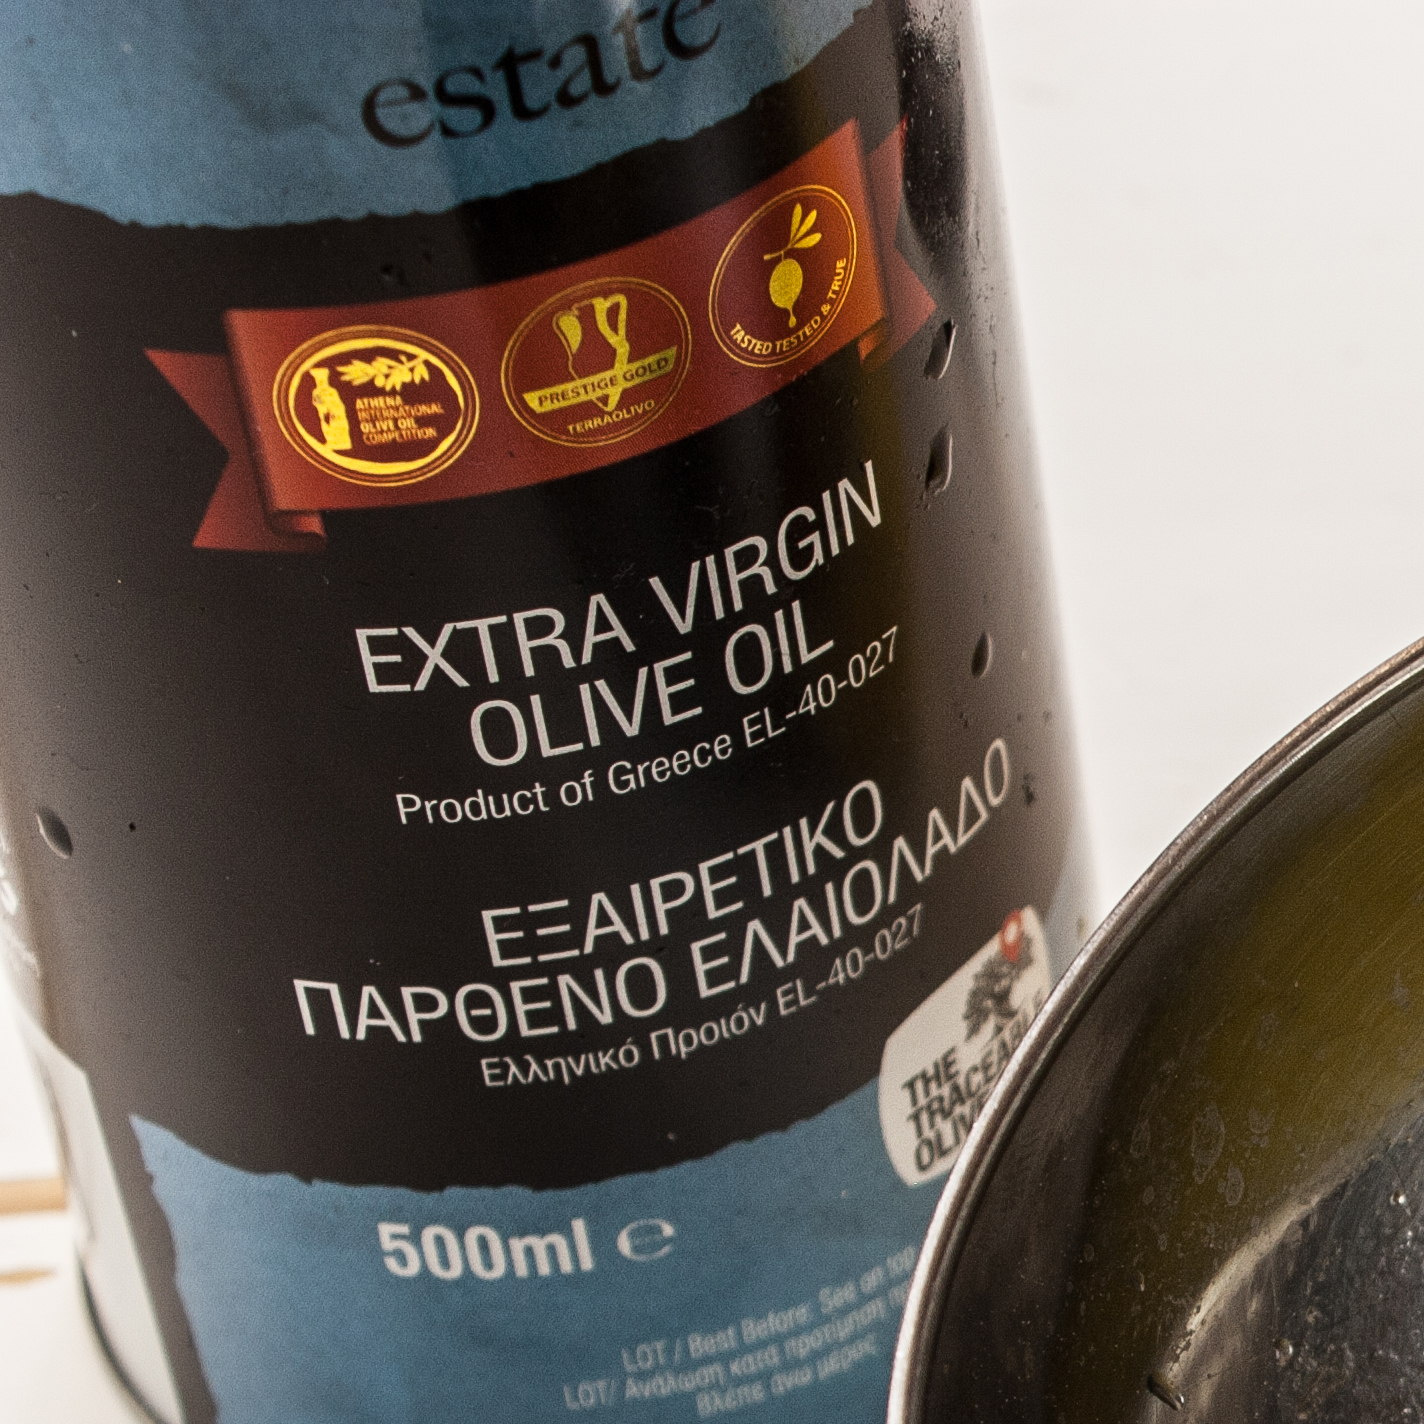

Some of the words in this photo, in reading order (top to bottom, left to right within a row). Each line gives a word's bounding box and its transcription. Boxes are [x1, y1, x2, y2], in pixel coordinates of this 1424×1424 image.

[361, 0, 722, 148] estate
[730, 322, 772, 355] TASTED
[775, 315, 822, 353] TESTED
[820, 302, 832, 316] &
[827, 257, 847, 300] TRUE
[355, 394, 403, 410] ATHENA
[357, 402, 445, 422] INTERNATIONAL
[359, 417, 396, 433] OLIVE
[397, 415, 417, 430] OIL
[537, 374, 619, 408] PRESTIGE
[622, 356, 669, 383] GOLD
[567, 399, 656, 435] TERRAOLIVO
[362, 426, 438, 446] COMPETITION
[355, 592, 636, 693] EXTRA
[648, 459, 882, 635] VIRGIN
[395, 782, 549, 824] Product
[560, 770, 595, 807] of
[608, 734, 732, 796] Greece
[742, 626, 898, 748] EL-40-027
[470, 651, 702, 766] OLIVE
[725, 600, 834, 695] OIL
[293, 957, 667, 1044] ΠΑΡΘΕΝΟ
[690, 738, 1009, 999] ΕΛΑΙΟΛΑΔΟ
[481, 779, 883, 967] ΕΞΑΙΡΕΤΙΚΟ
[481, 1037, 640, 1087] Ελληνικό
[776, 903, 923, 1016] EL-40-027
[901, 1046, 960, 1108] THE
[914, 1092, 986, 1173] OLIV
[377, 1217, 594, 1280] 500ml
[620, 1339, 667, 1373] LOT
[686, 1326, 738, 1359] Best
[818, 1280, 858, 1315] See
